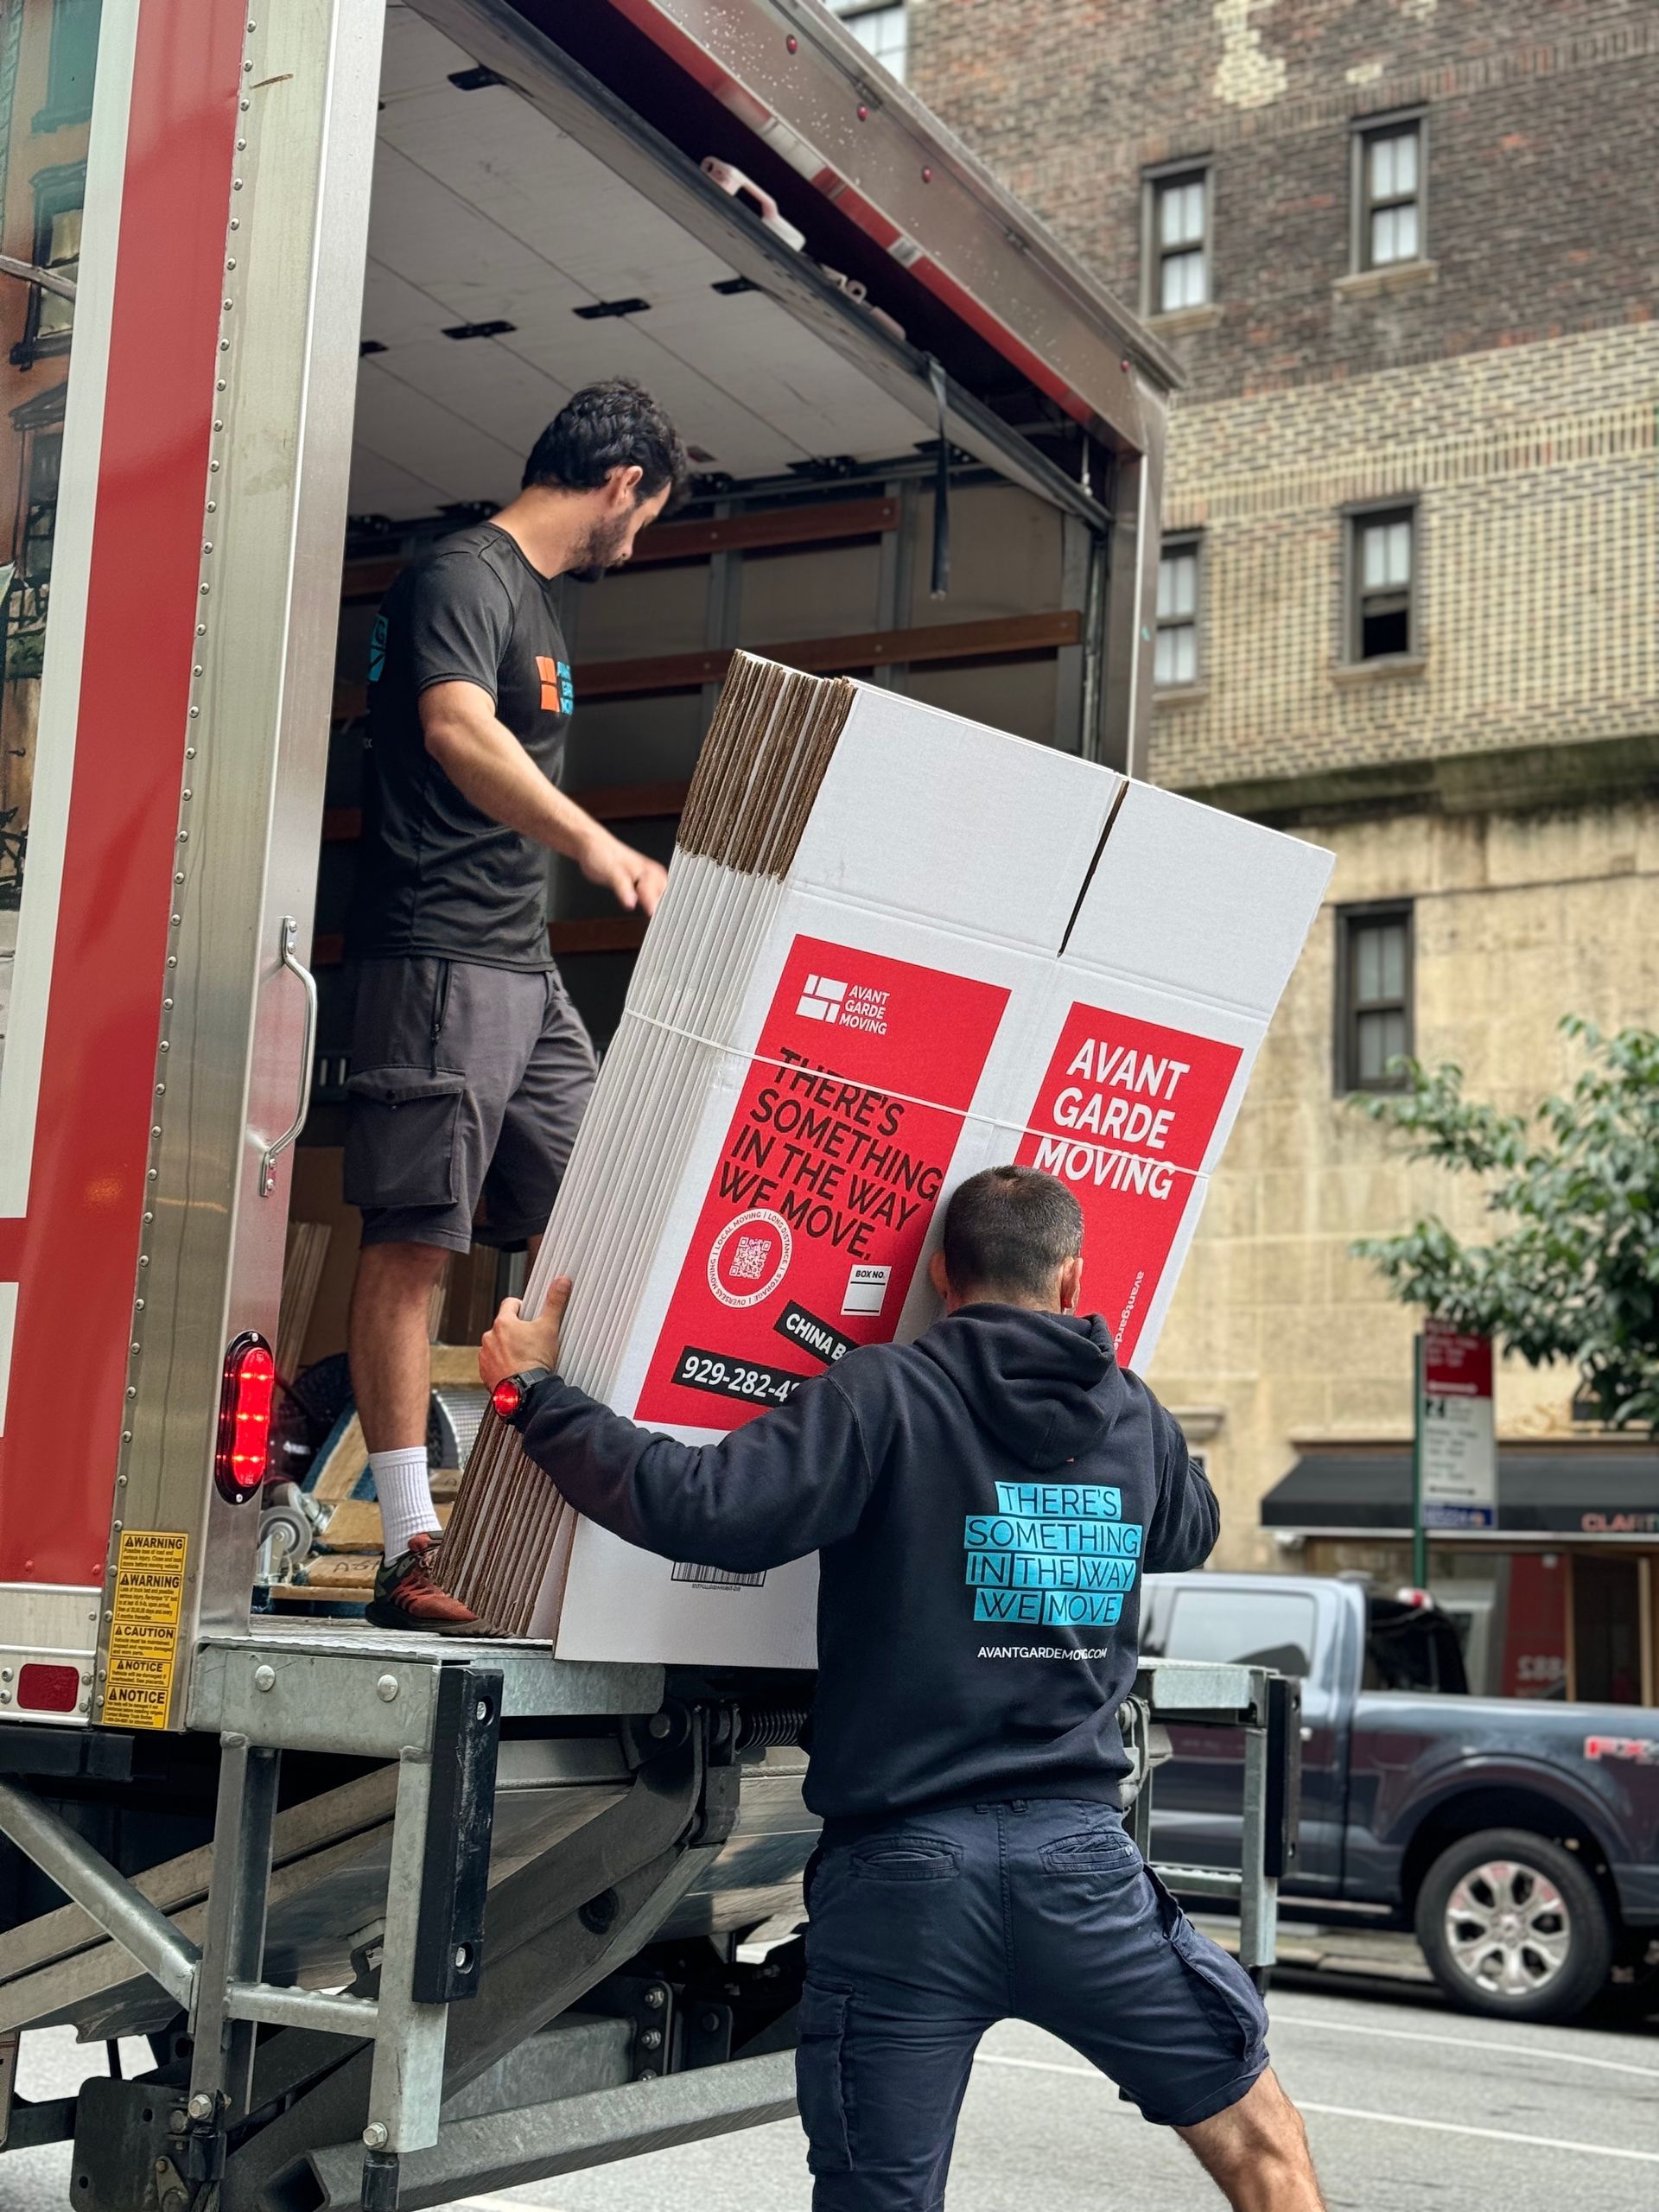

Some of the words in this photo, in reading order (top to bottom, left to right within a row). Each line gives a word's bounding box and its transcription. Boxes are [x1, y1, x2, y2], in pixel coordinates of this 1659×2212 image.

[845, 1000, 886, 1020] GARDE
[849, 985, 890, 1004] AVANT
[839, 1013, 887, 1035] MOVING
[1066, 1038, 1191, 1103] AVANT
[774, 1046, 905, 1136] THERE'S
[1053, 1088, 1176, 1150] GARDE
[751, 1089, 944, 1202] SOMETHING
[732, 1124, 775, 1168] IN
[778, 1143, 846, 1200] THE
[848, 1174, 921, 1232] WAY
[1032, 1136, 1176, 1200] MOVING
[719, 1161, 778, 1211] WE
[779, 1191, 876, 1261] MOVE.
[715, 1227, 734, 1249] LOCAL
[733, 1211, 761, 1227] MOVING
[767, 1213, 783, 1229] LONG
[781, 1227, 791, 1264] DISTANCE
[709, 1258, 719, 1290] MOVING
[753, 1273, 781, 1301] STORAGE
[855, 1269, 870, 1278] BOX
[785, 1313, 833, 1356] CHINA
[832, 1343, 848, 1360] B
[681, 1356, 800, 1402] 929-282-4
[1000, 1485, 1118, 1517] THERE'S
[133, 1536, 183, 1549] WARNING
[967, 1519, 1139, 1554] SOMETHING
[130, 1575, 180, 1588] WARNING
[970, 1556, 1006, 1583] IN
[1016, 1557, 1075, 1586] THE
[1082, 1560, 1135, 1589] WAY
[980, 1591, 1038, 1620] WE
[1048, 1594, 1117, 1623] MOVE.
[124, 1626, 174, 1638] CAUTION
[126, 1660, 162, 1672] NOTICE
[118, 1689, 165, 1704] NOTICE
